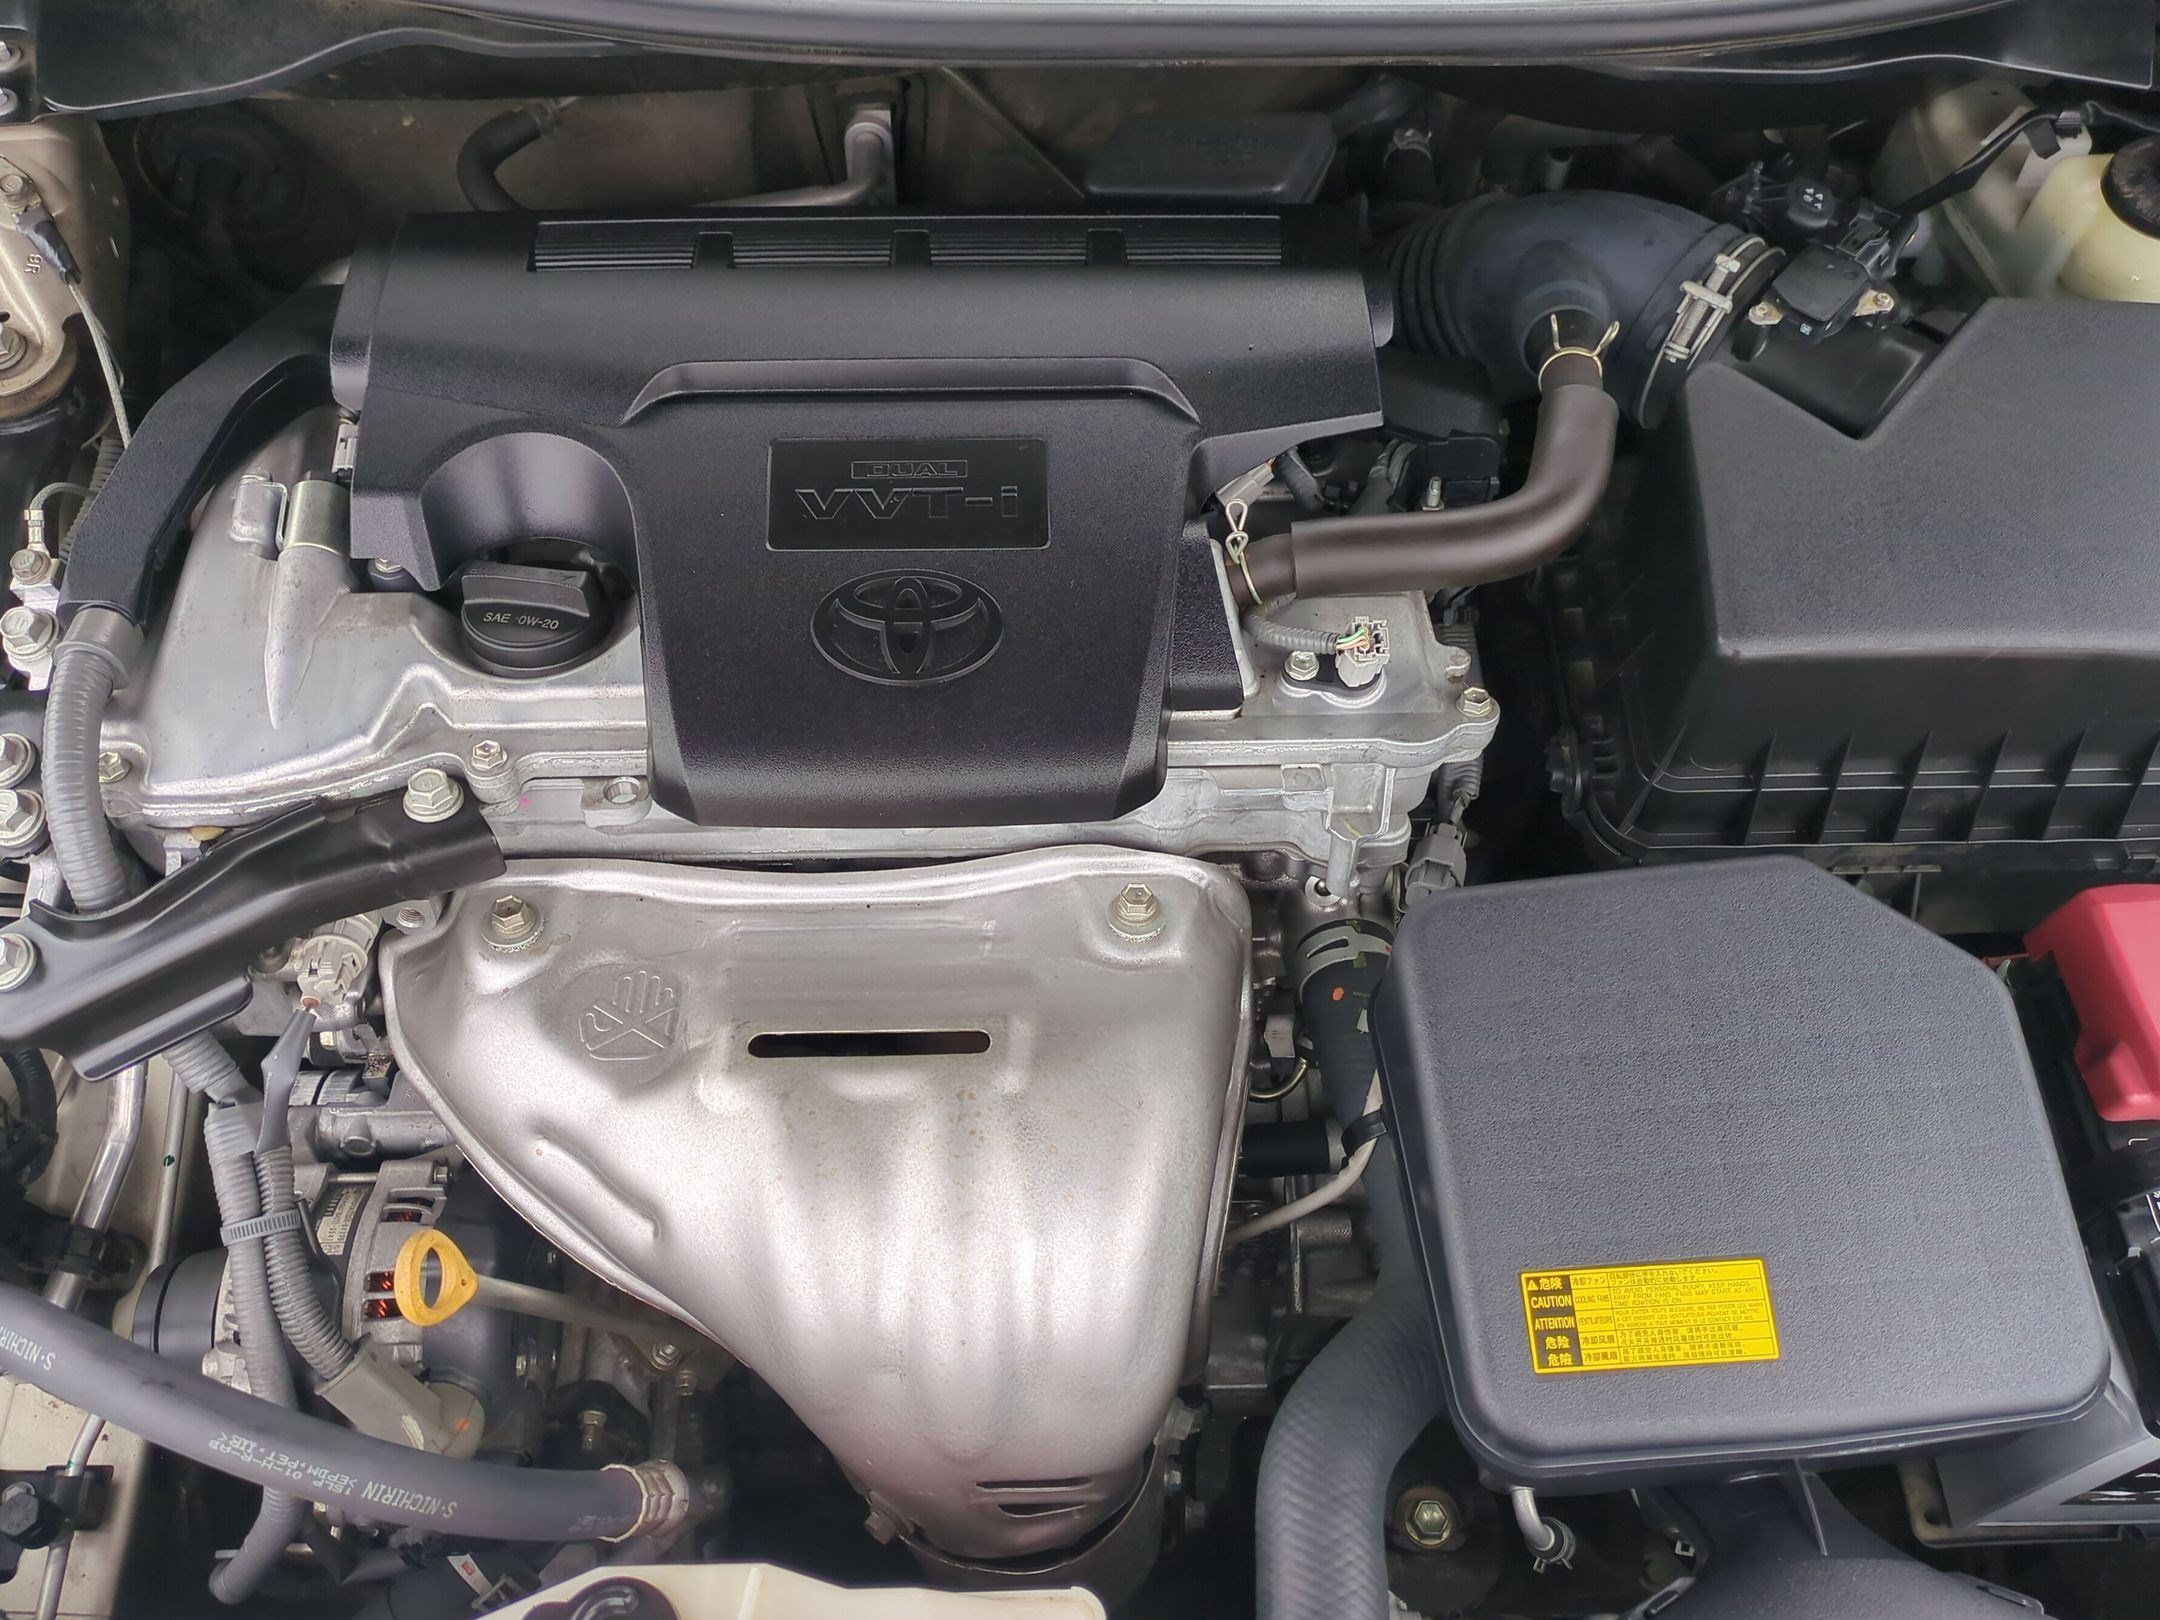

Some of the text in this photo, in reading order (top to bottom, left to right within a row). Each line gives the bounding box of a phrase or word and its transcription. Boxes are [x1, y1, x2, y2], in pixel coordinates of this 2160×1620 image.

[866, 462, 959, 478] DUAL
[795, 485, 1018, 520] VVT-i
[483, 611, 560, 630] SAE 0W-20
[1538, 1277, 1563, 1290] 危険
[1530, 1294, 1572, 1308] CAUTION
[1533, 1316, 1574, 1330] ATTENTION
[1544, 1335, 1570, 1349] 危险
[1546, 1352, 1573, 1366] 危險
